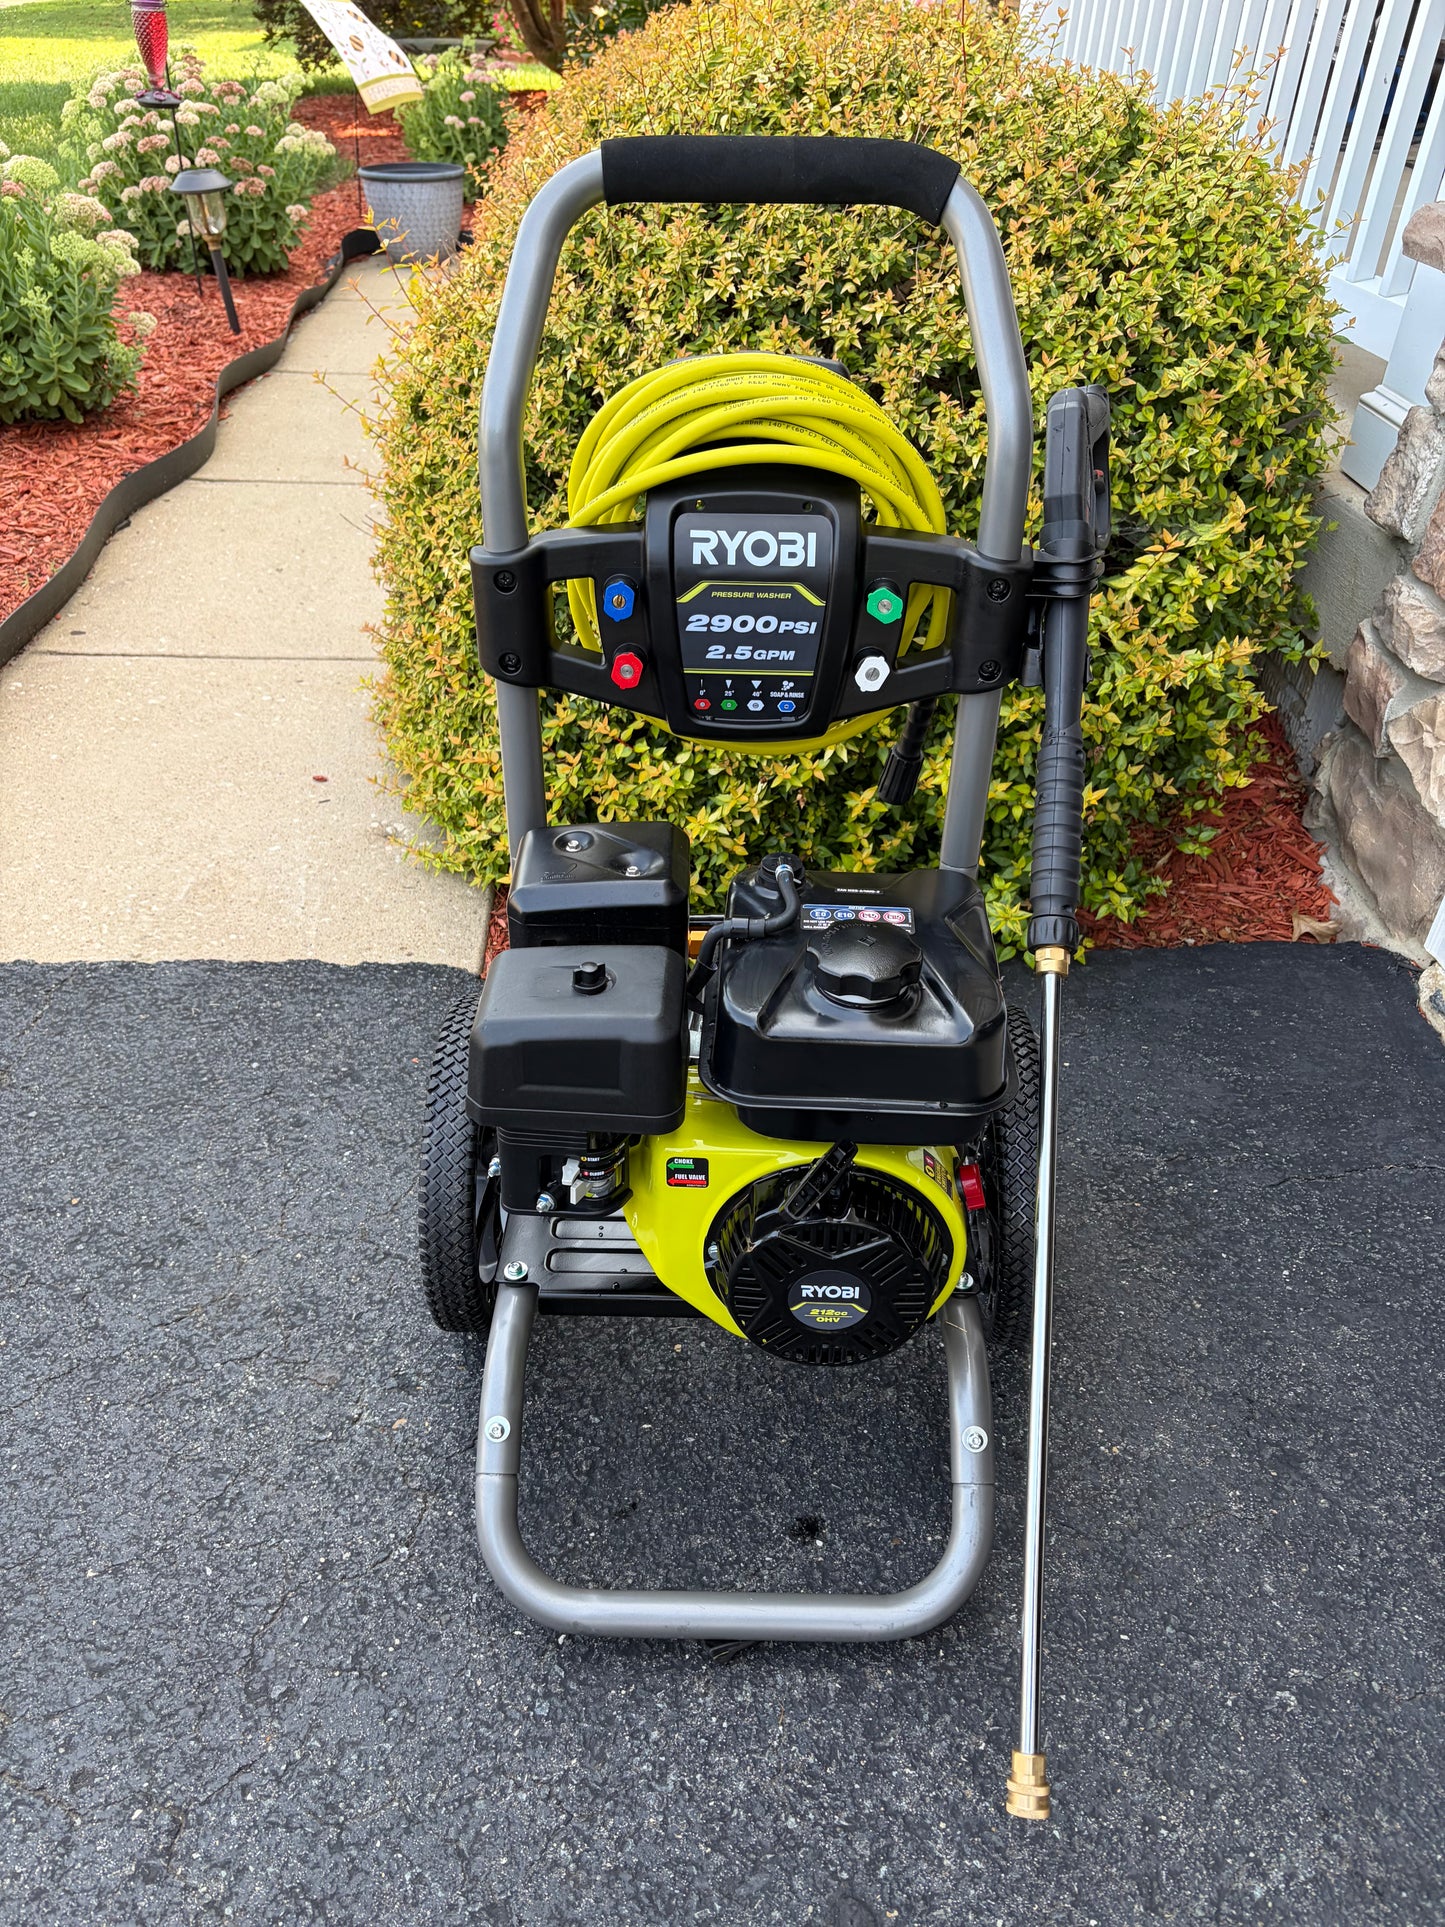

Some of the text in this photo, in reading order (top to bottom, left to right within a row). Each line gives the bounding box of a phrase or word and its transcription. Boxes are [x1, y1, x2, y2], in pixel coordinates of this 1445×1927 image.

[690, 530, 817, 568] RYOBI
[711, 591, 792, 600] PRESSURE WASHER
[800, 1285, 860, 1299] RYOBI
